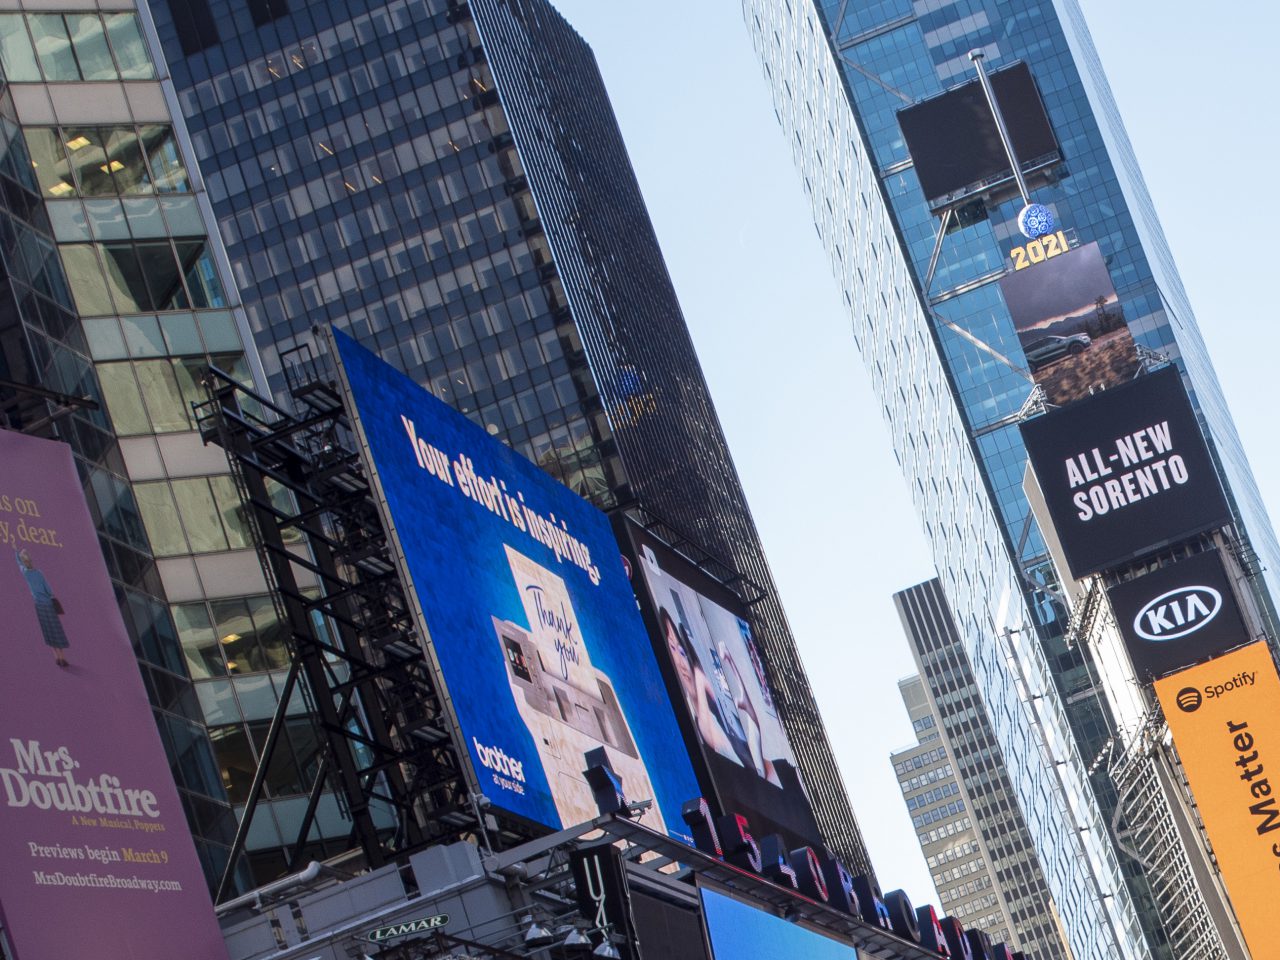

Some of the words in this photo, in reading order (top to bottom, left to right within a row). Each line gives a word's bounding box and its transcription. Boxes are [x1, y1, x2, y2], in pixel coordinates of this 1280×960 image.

[1009, 230, 1070, 272] 2021
[400, 414, 454, 487] Your
[454, 453, 502, 516] effort
[500, 480, 526, 532] is
[1065, 420, 1174, 489] ALL-NEW
[15, 497, 41, 518] on
[1072, 453, 1190, 522] SORENTO
[17, 518, 64, 548] dear.
[525, 585, 578, 645] Thank
[1146, 593, 1211, 635] KIA
[554, 636, 580, 681] you
[1204, 671, 1256, 699] Spotify
[9, 737, 80, 777] Mrs.
[472, 737, 526, 783] brother
[0, 767, 160, 818] Doubtfire
[28, 841, 84, 861] Previews
[85, 844, 121, 864] begin
[121, 847, 160, 864] March
[160, 850, 169, 864] 9
[33, 870, 182, 893] MrsDoubtfireBroadway.com
[374, 916, 444, 940] LAMAR
